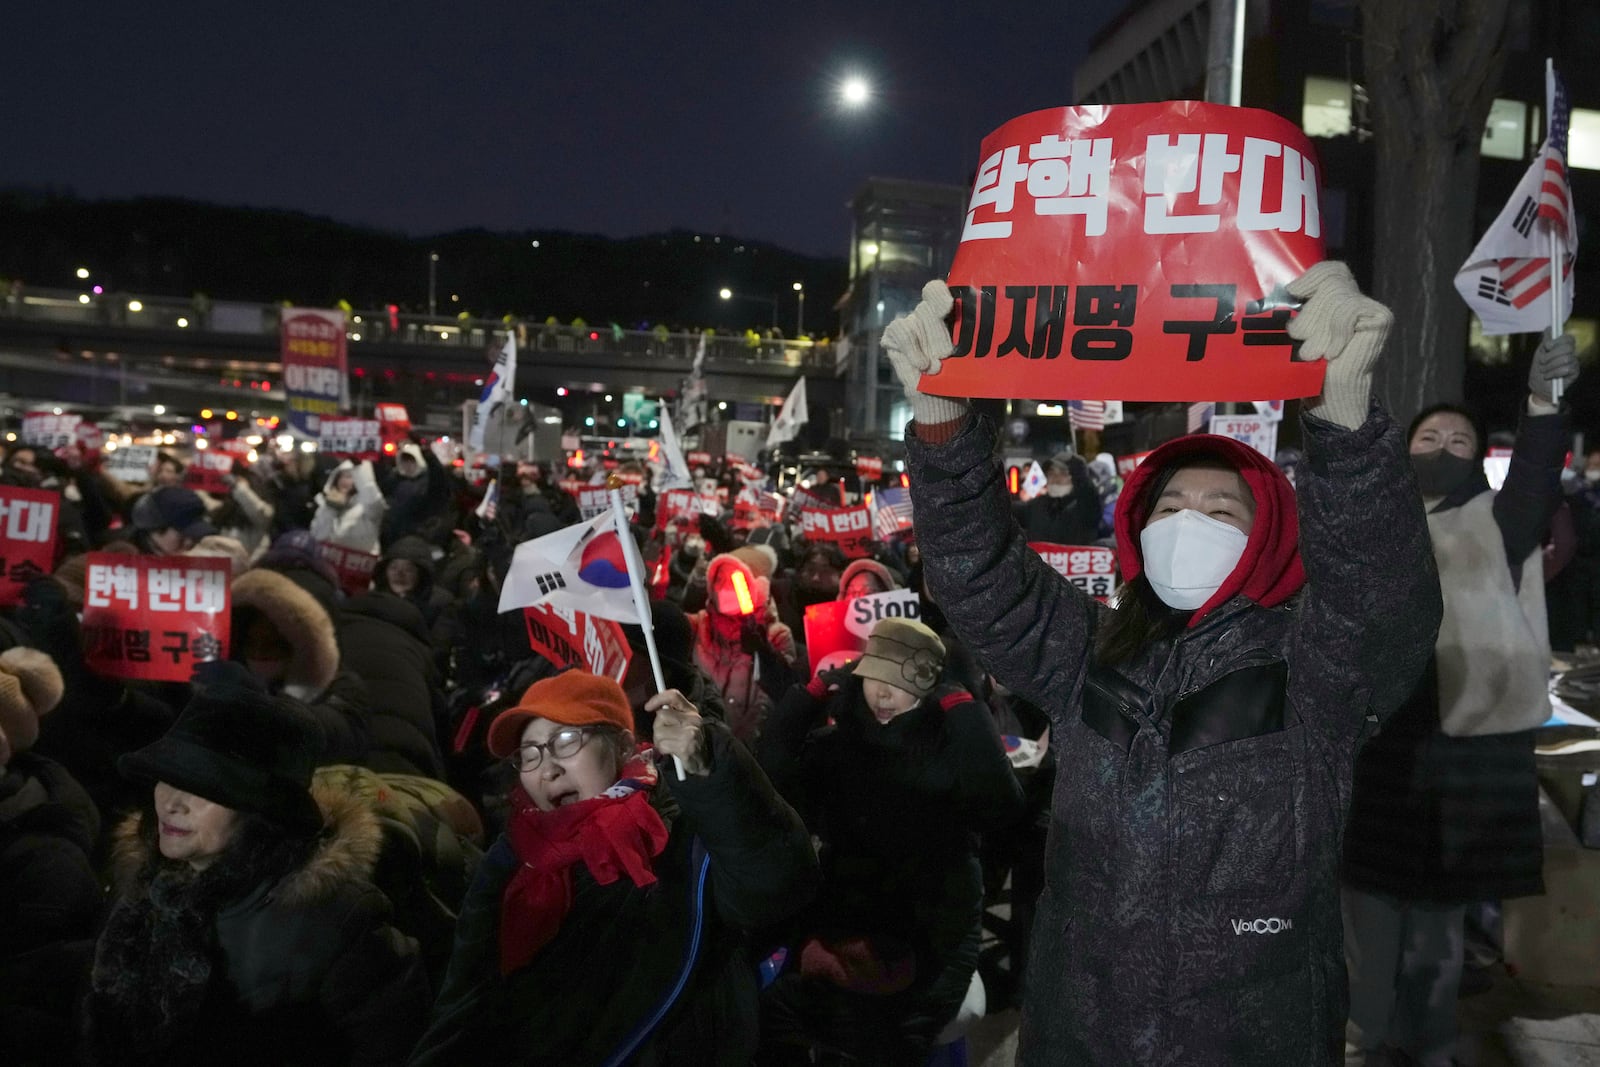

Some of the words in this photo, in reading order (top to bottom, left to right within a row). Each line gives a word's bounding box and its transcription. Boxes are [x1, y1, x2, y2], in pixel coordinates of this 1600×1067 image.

[961, 134, 1112, 243] 탄핵
[1144, 133, 1321, 239] 반대
[951, 284, 1138, 361] 이재명
[1226, 422, 1261, 434] STOP
[0, 498, 53, 543] 대
[832, 509, 869, 533] 반대
[1038, 551, 1113, 575] 법영장
[88, 564, 138, 610] 탄핵
[148, 568, 225, 613] 반대
[854, 598, 920, 624] Stop
